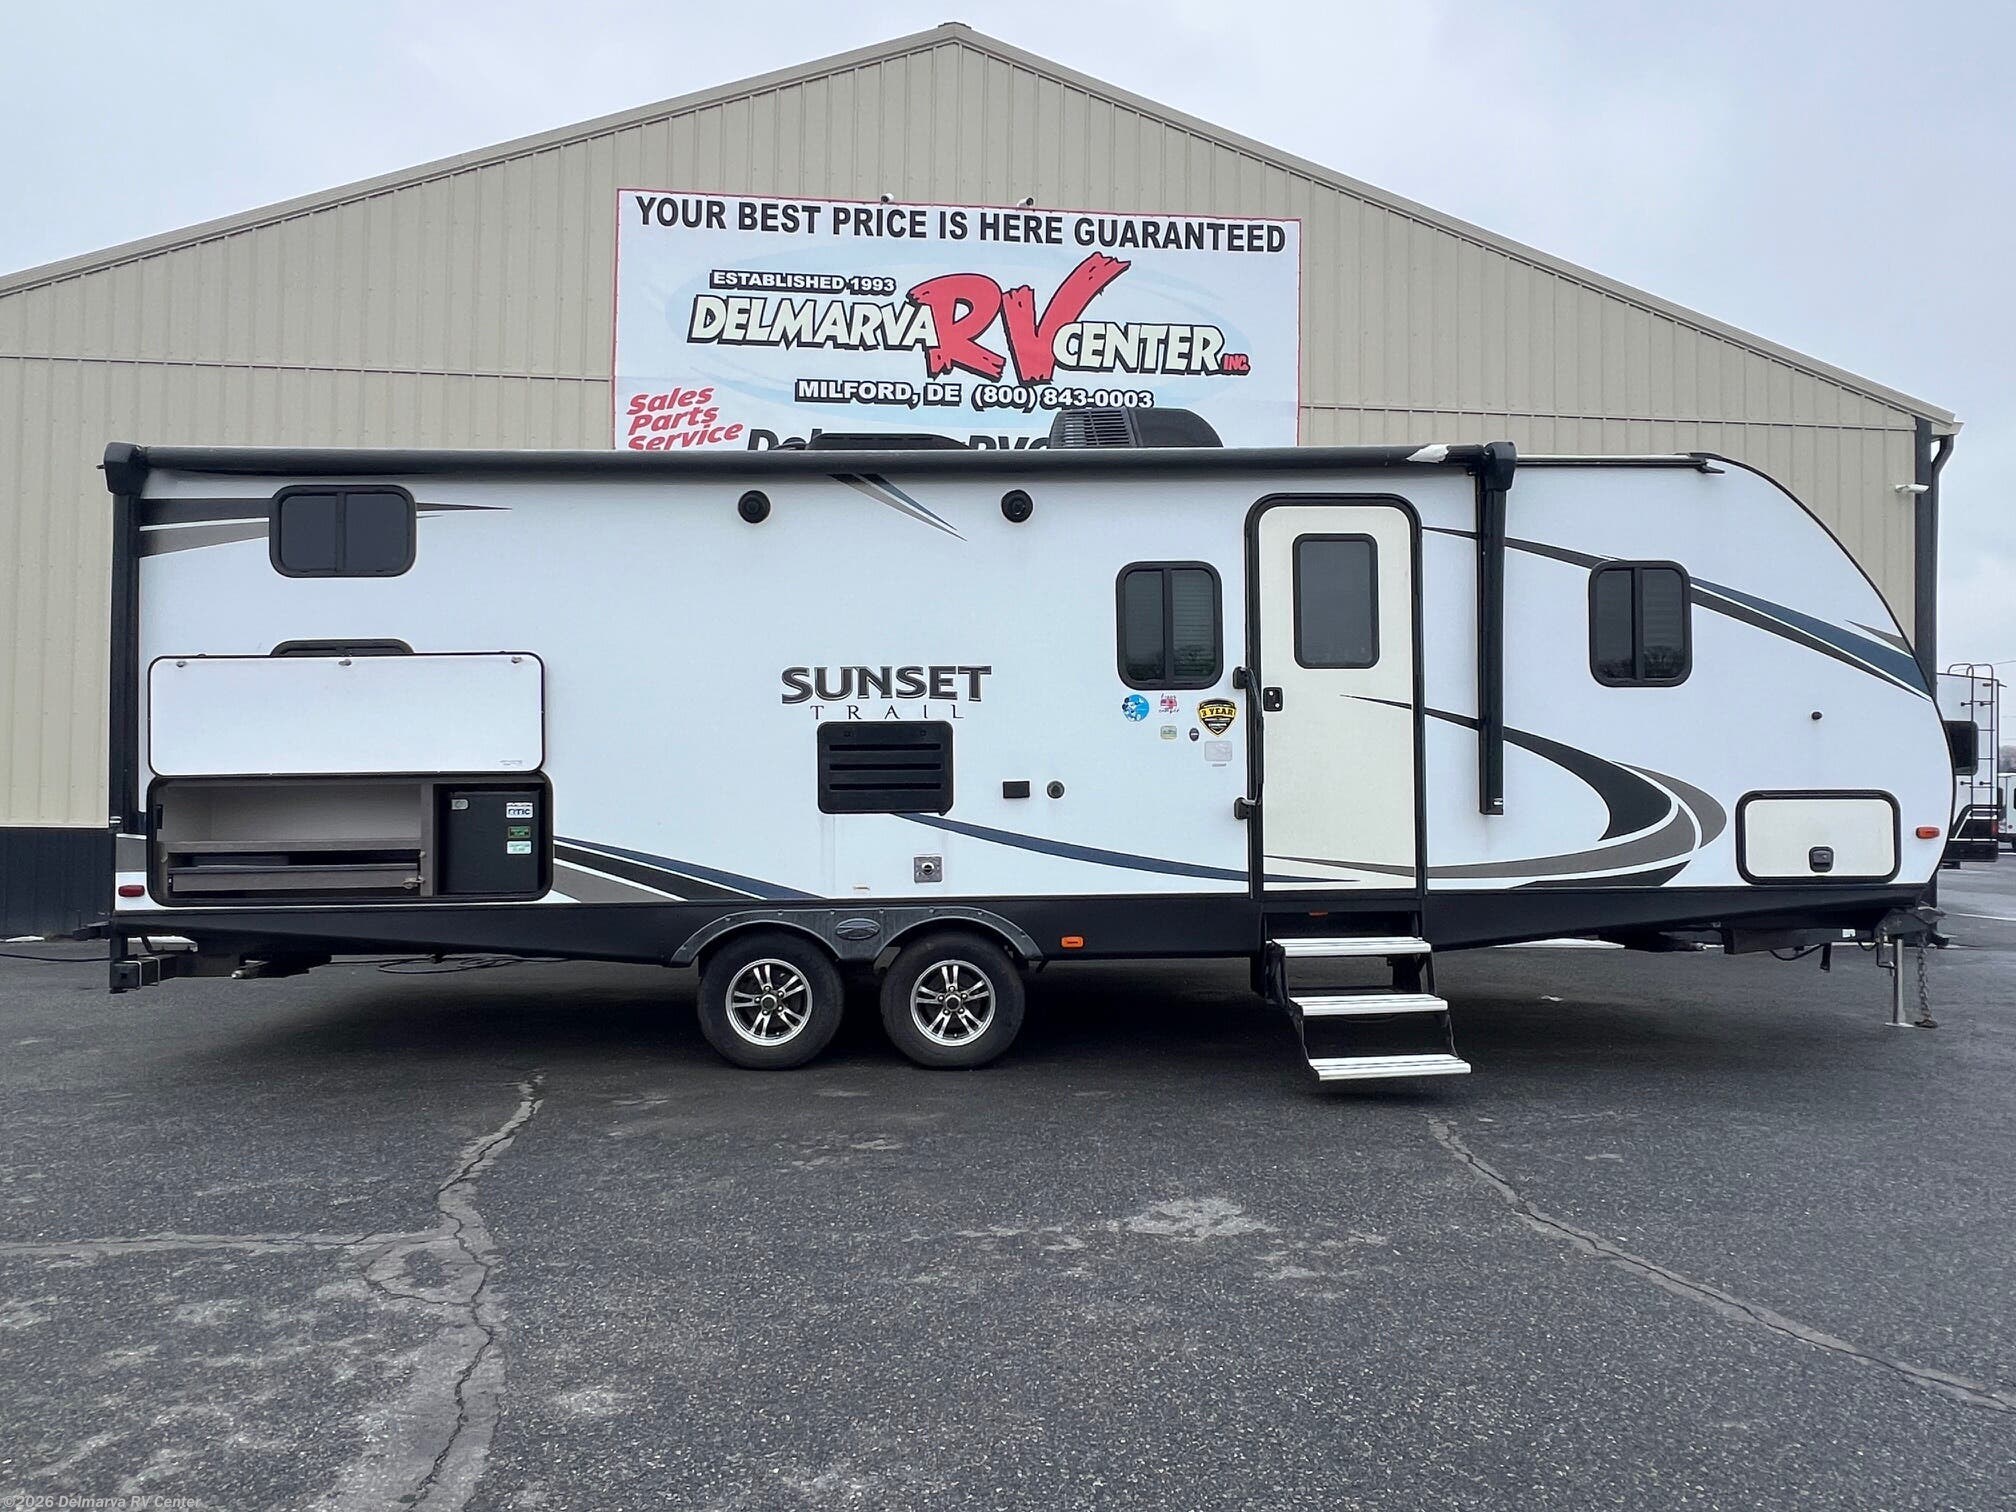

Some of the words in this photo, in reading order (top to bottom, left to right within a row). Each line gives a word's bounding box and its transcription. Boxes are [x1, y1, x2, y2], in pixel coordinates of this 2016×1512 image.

[636, 196, 725, 229] YOUR
[738, 202, 821, 234] BEST
[833, 206, 927, 239] PRICE
[940, 211, 968, 240] IS
[980, 212, 1063, 244] HERE
[1074, 218, 1286, 252] GUARANTEED
[711, 271, 845, 291] ESTABLISHED
[850, 277, 895, 294] 1993
[688, 295, 940, 349] DELMARVA
[906, 251, 1131, 385] RV
[1053, 321, 1224, 375] CENTER
[627, 388, 714, 415] Sales
[796, 380, 919, 408] MILFORD,
[924, 382, 961, 405] DE
[973, 385, 1037, 411] (800)
[1042, 388, 1153, 409] 843-0003
[628, 407, 719, 436] Parts
[628, 423, 743, 450] Service
[781, 665, 992, 703] SUNSET
[810, 705, 964, 720] TRAIL
[1209, 707, 1234, 716] YEAR
